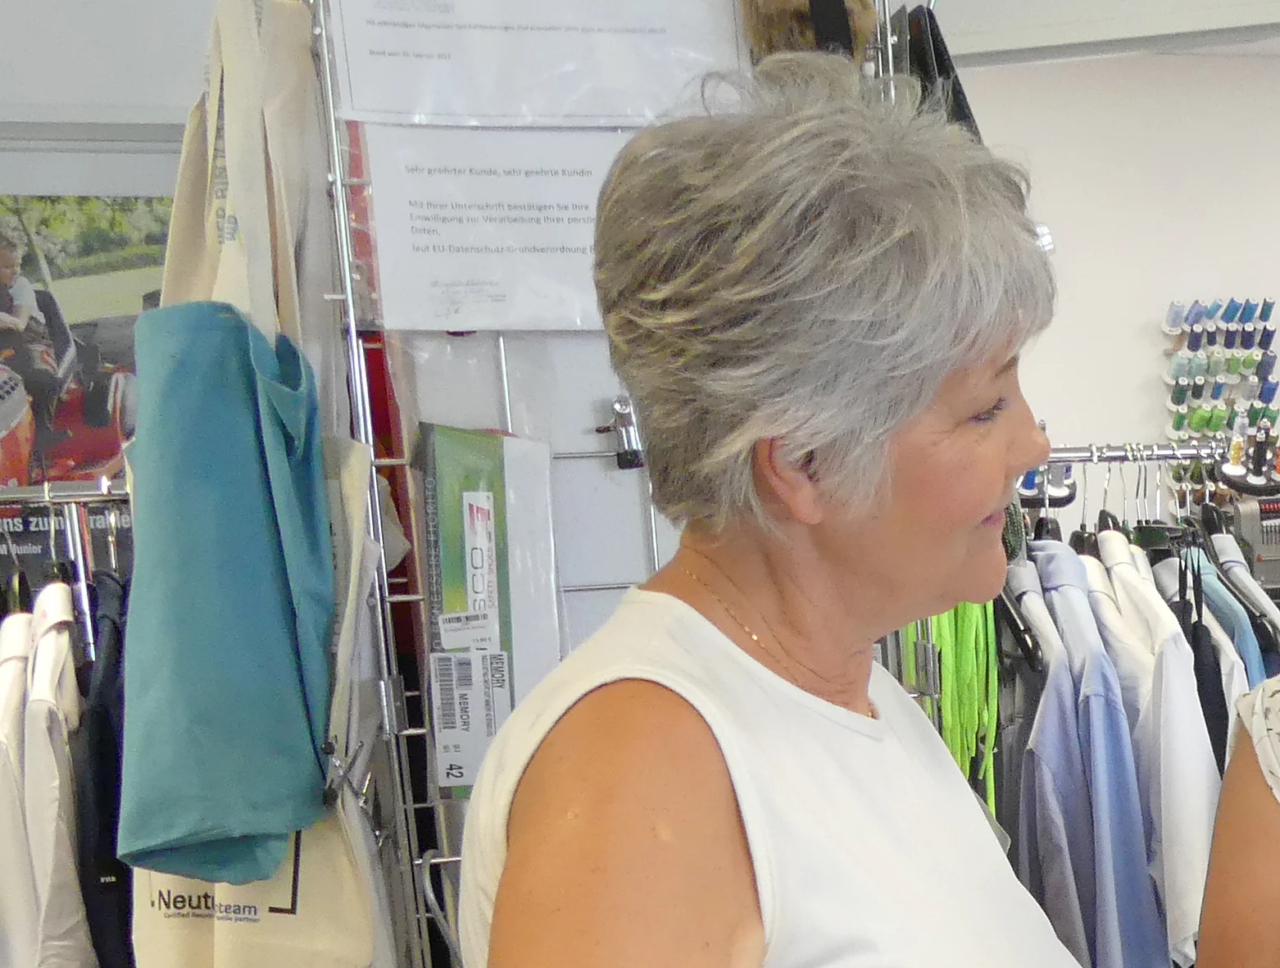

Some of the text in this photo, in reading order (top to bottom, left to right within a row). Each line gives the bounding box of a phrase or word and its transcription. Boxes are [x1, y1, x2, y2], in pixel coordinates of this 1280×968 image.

[490, 653, 505, 690] MEMORY
[456, 693, 470, 732] MEMORY
[445, 763, 464, 779] 42
